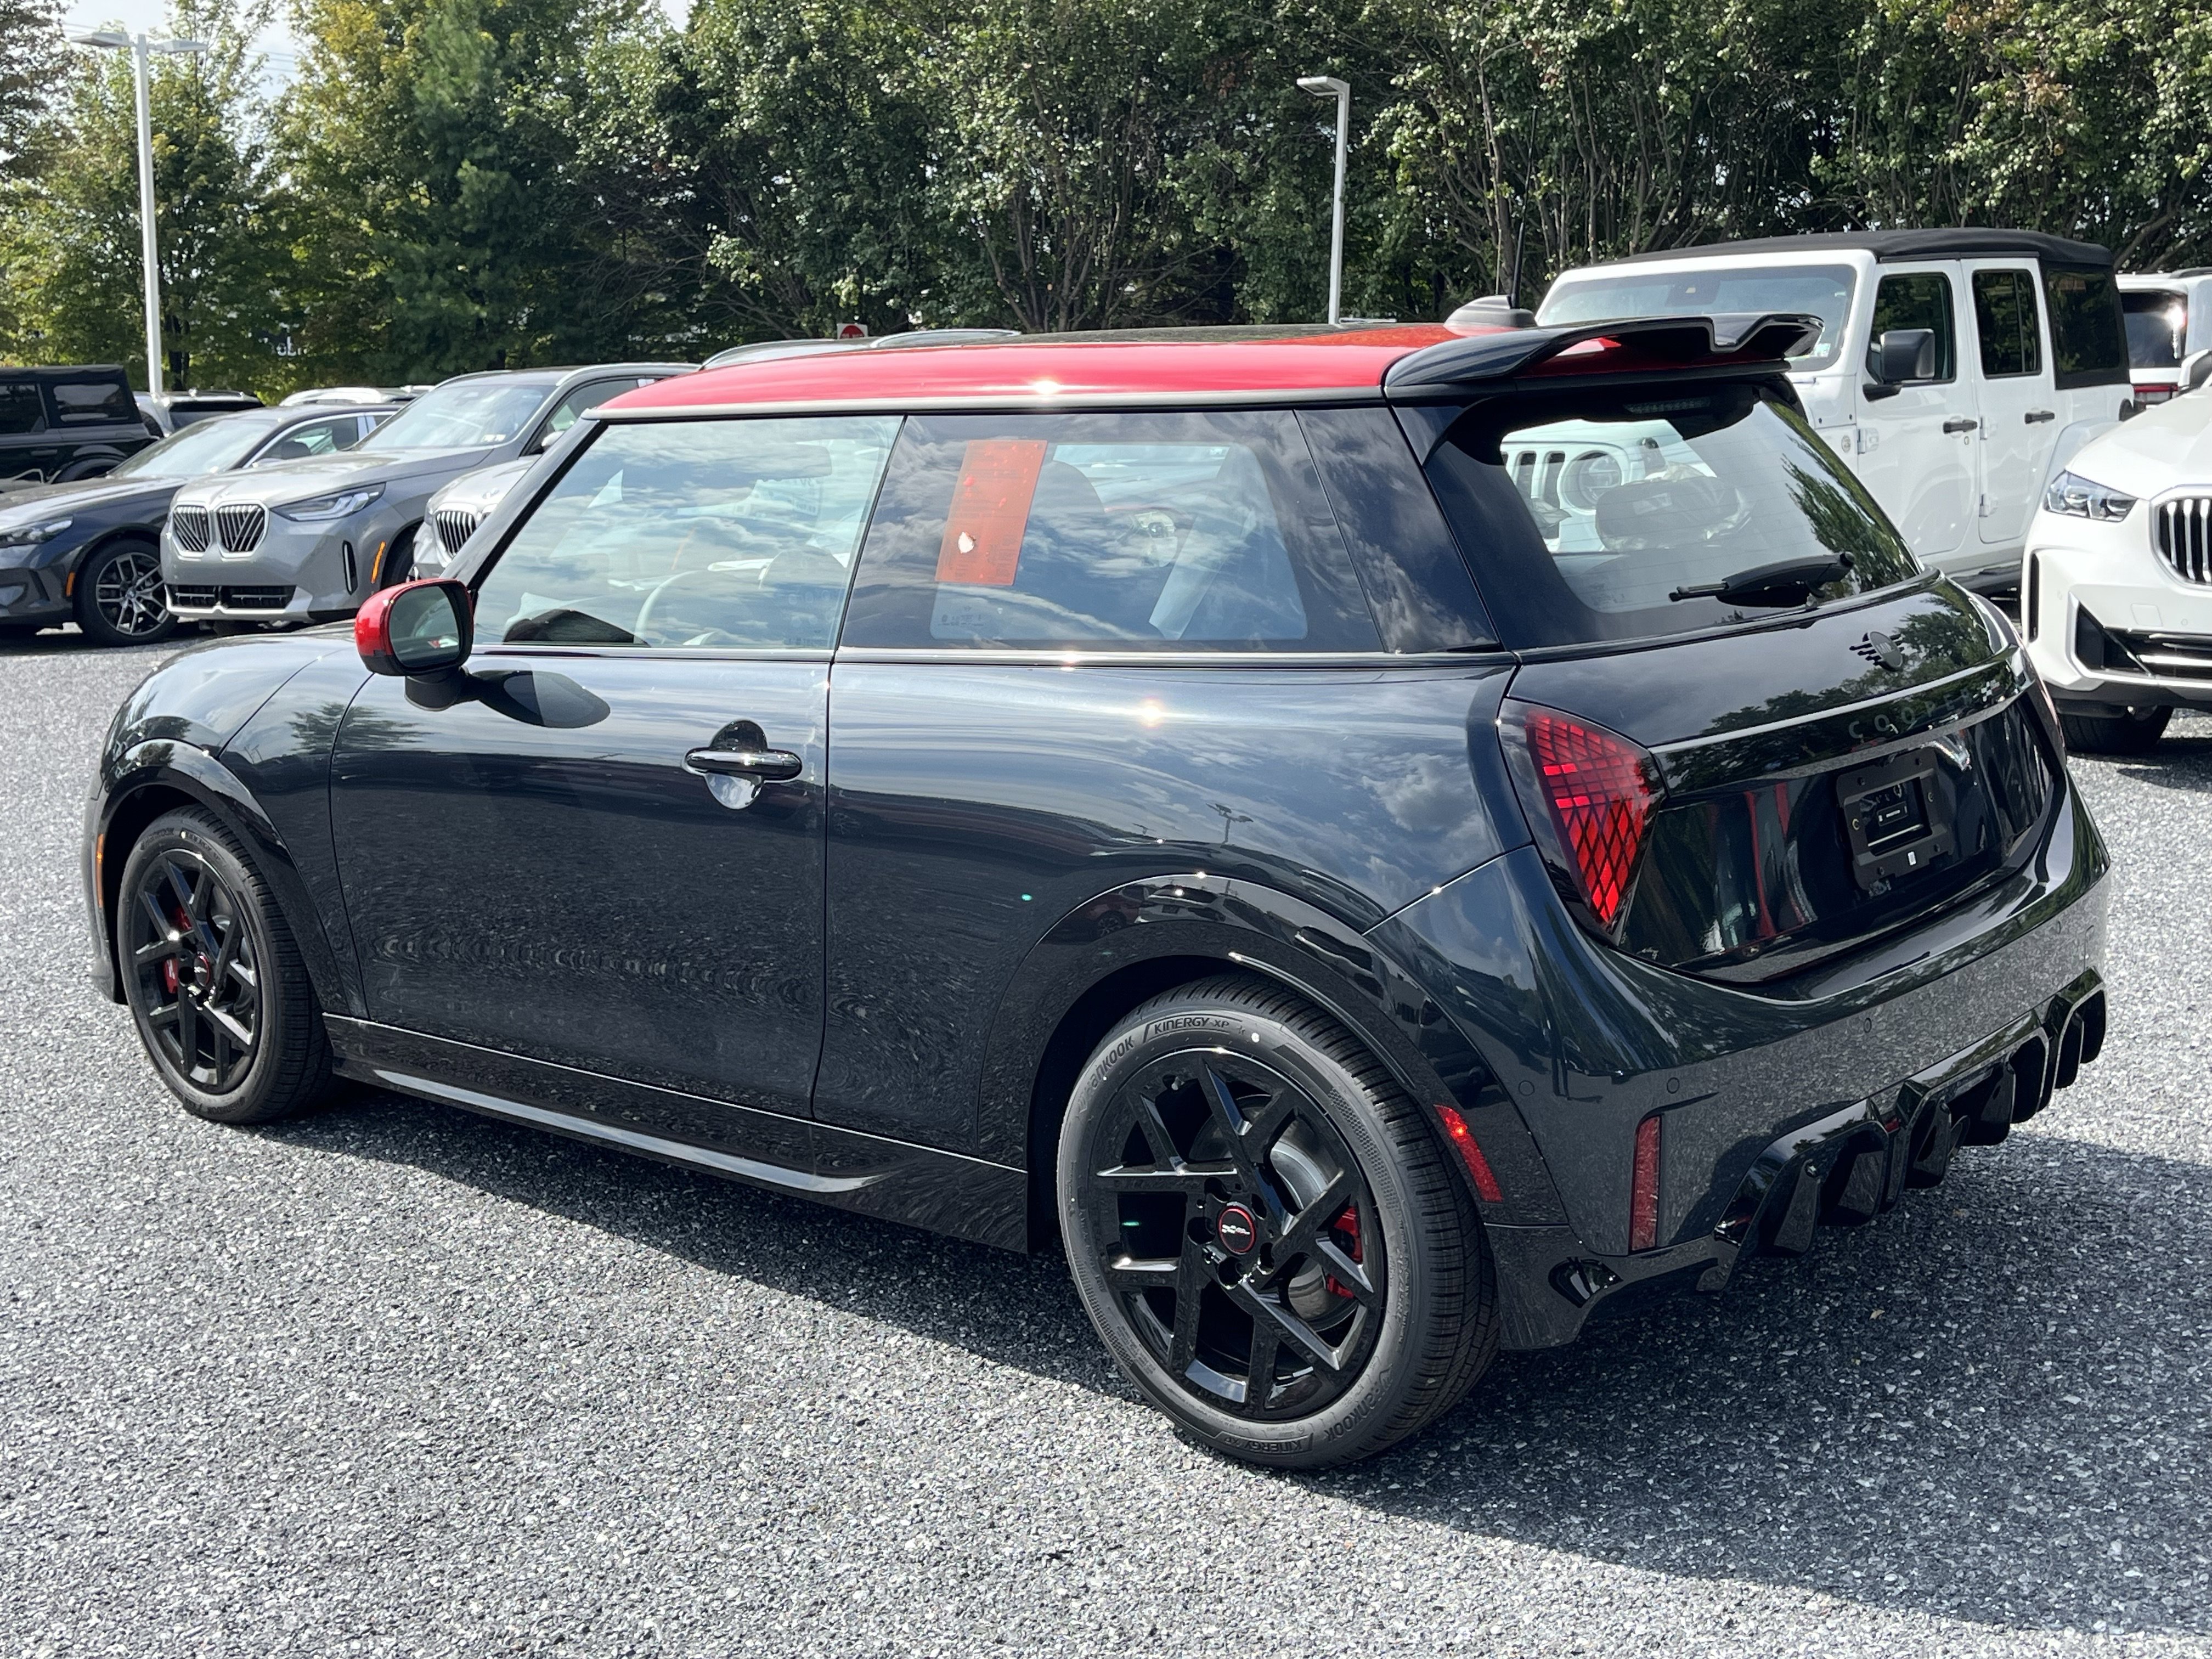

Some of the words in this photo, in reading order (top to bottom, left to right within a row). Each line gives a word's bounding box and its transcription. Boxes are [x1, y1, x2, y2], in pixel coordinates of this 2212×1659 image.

[1849, 687, 1973, 739] COOPER
[1154, 1017, 1210, 1035] KINERGY
[1214, 1019, 1229, 1028] XP
